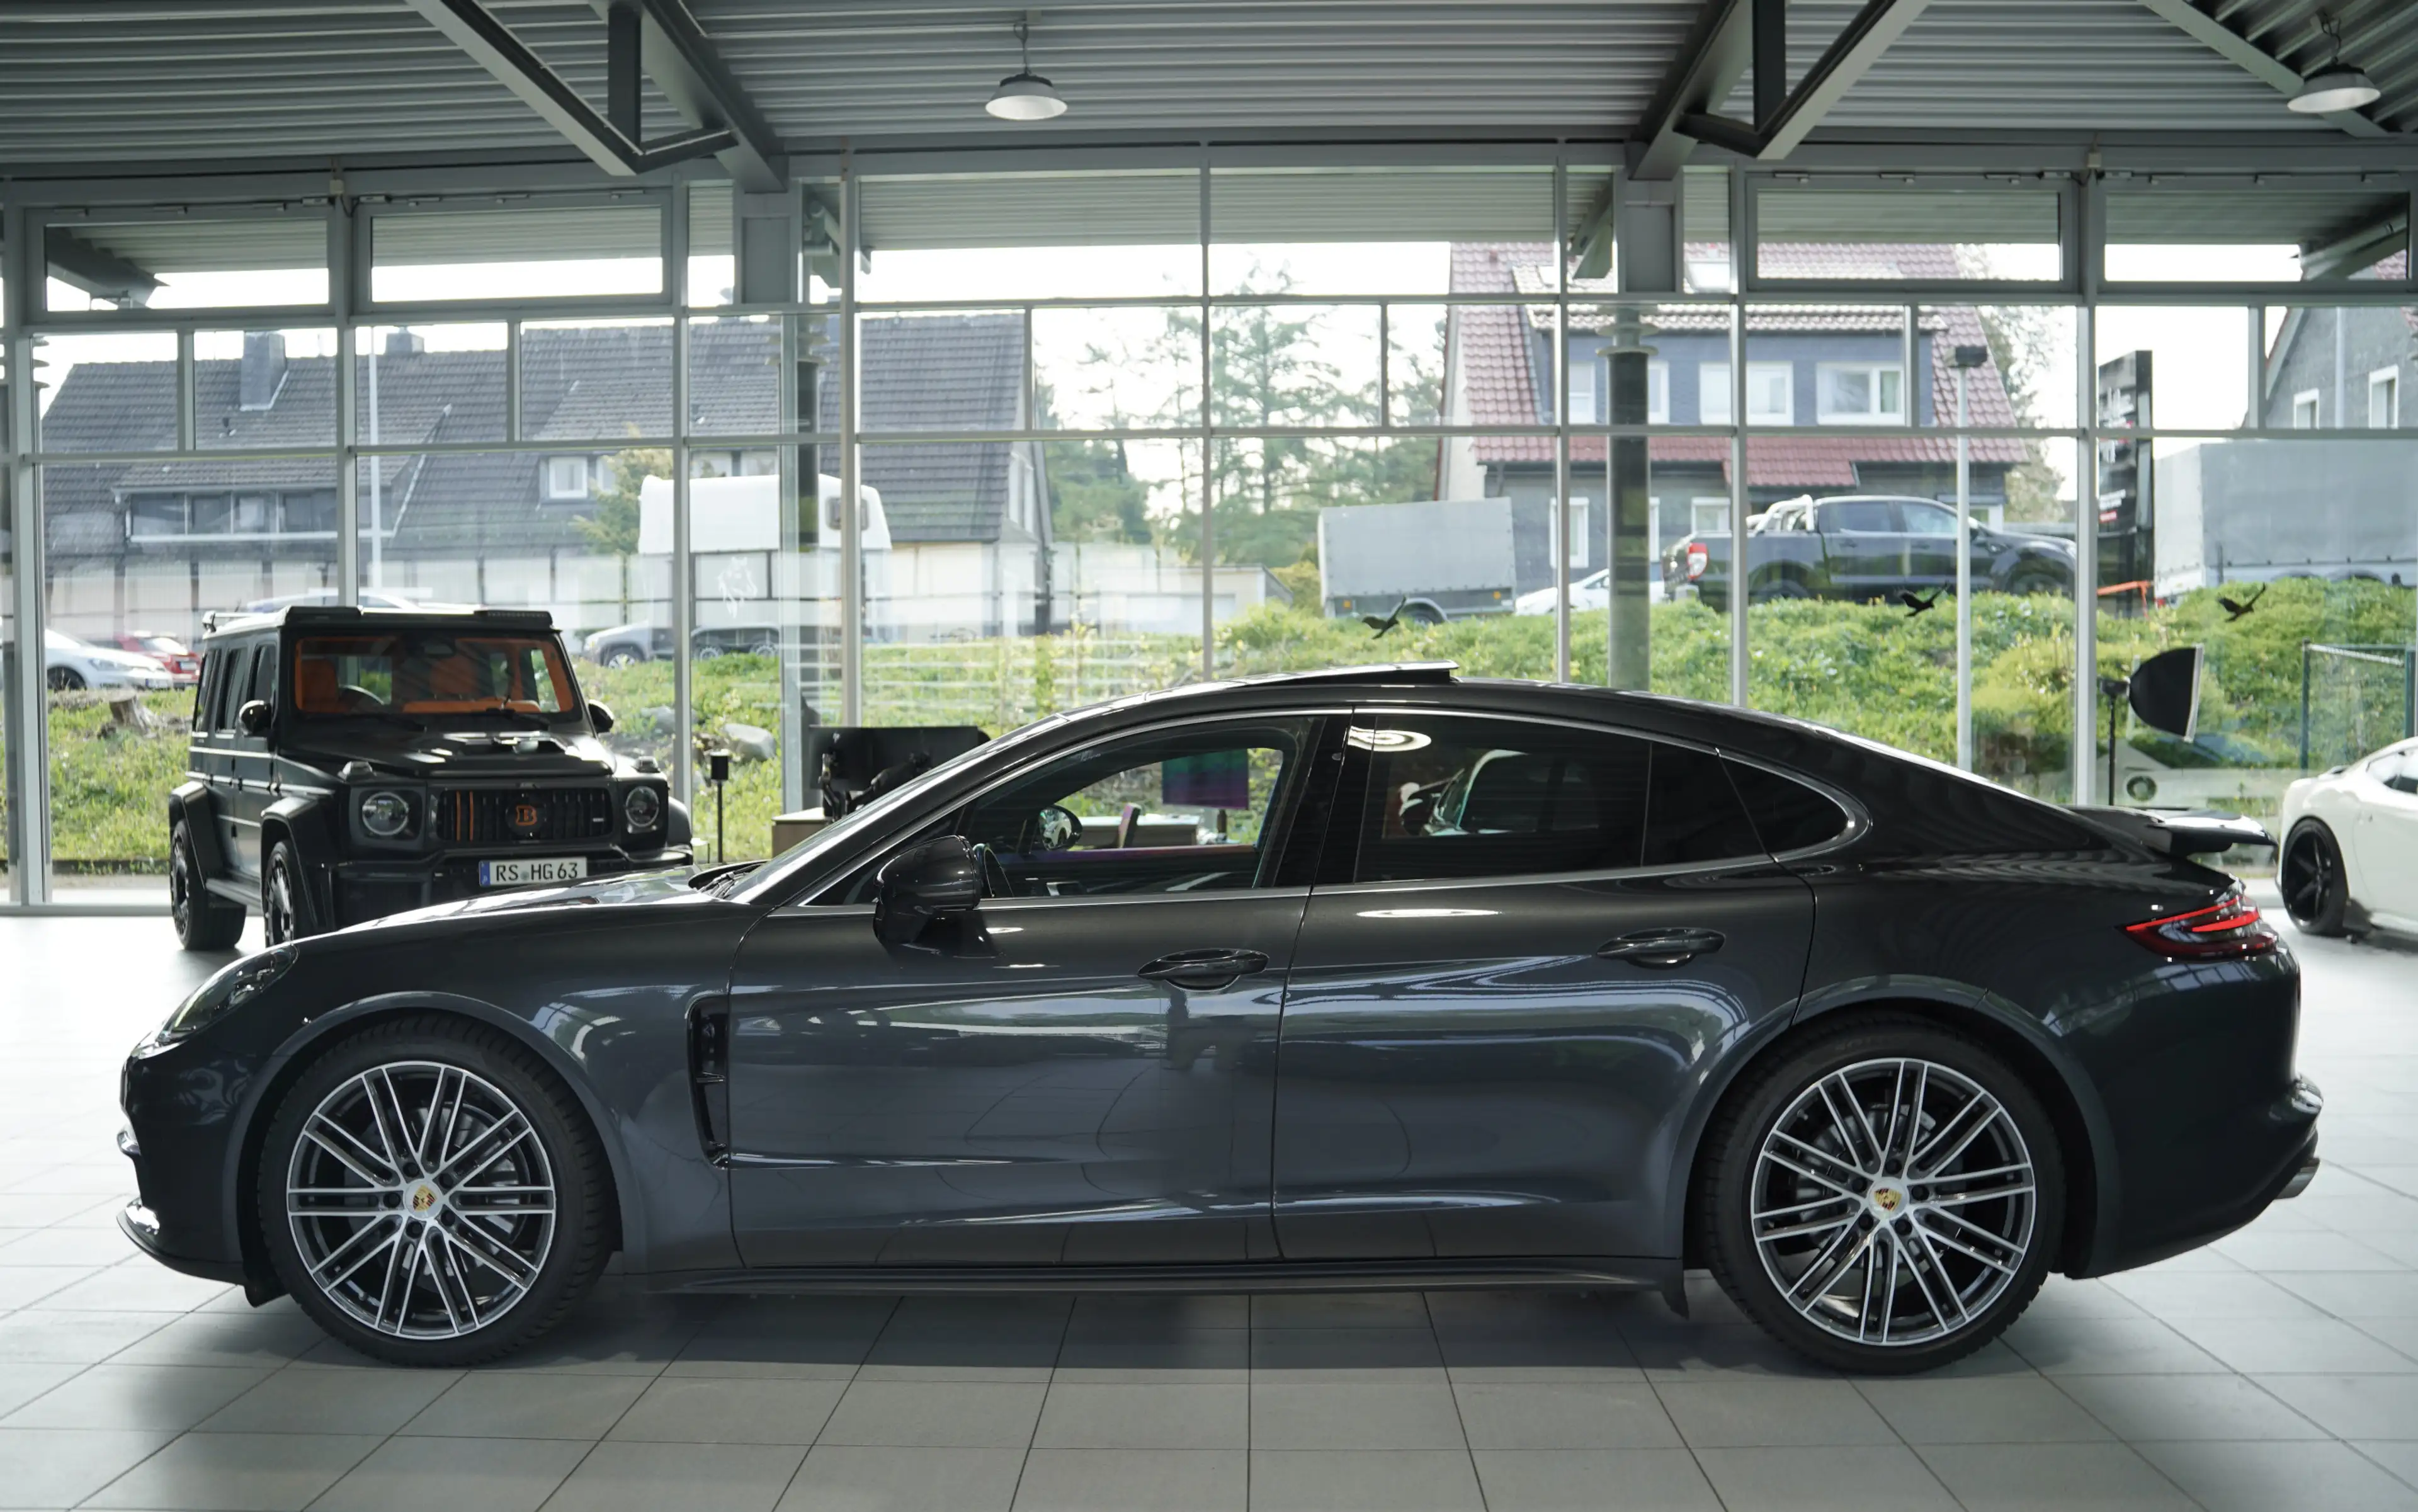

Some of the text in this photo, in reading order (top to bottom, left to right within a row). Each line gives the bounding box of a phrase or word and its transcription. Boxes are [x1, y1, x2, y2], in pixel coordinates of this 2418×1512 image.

[496, 862, 578, 882] RS HG 63
